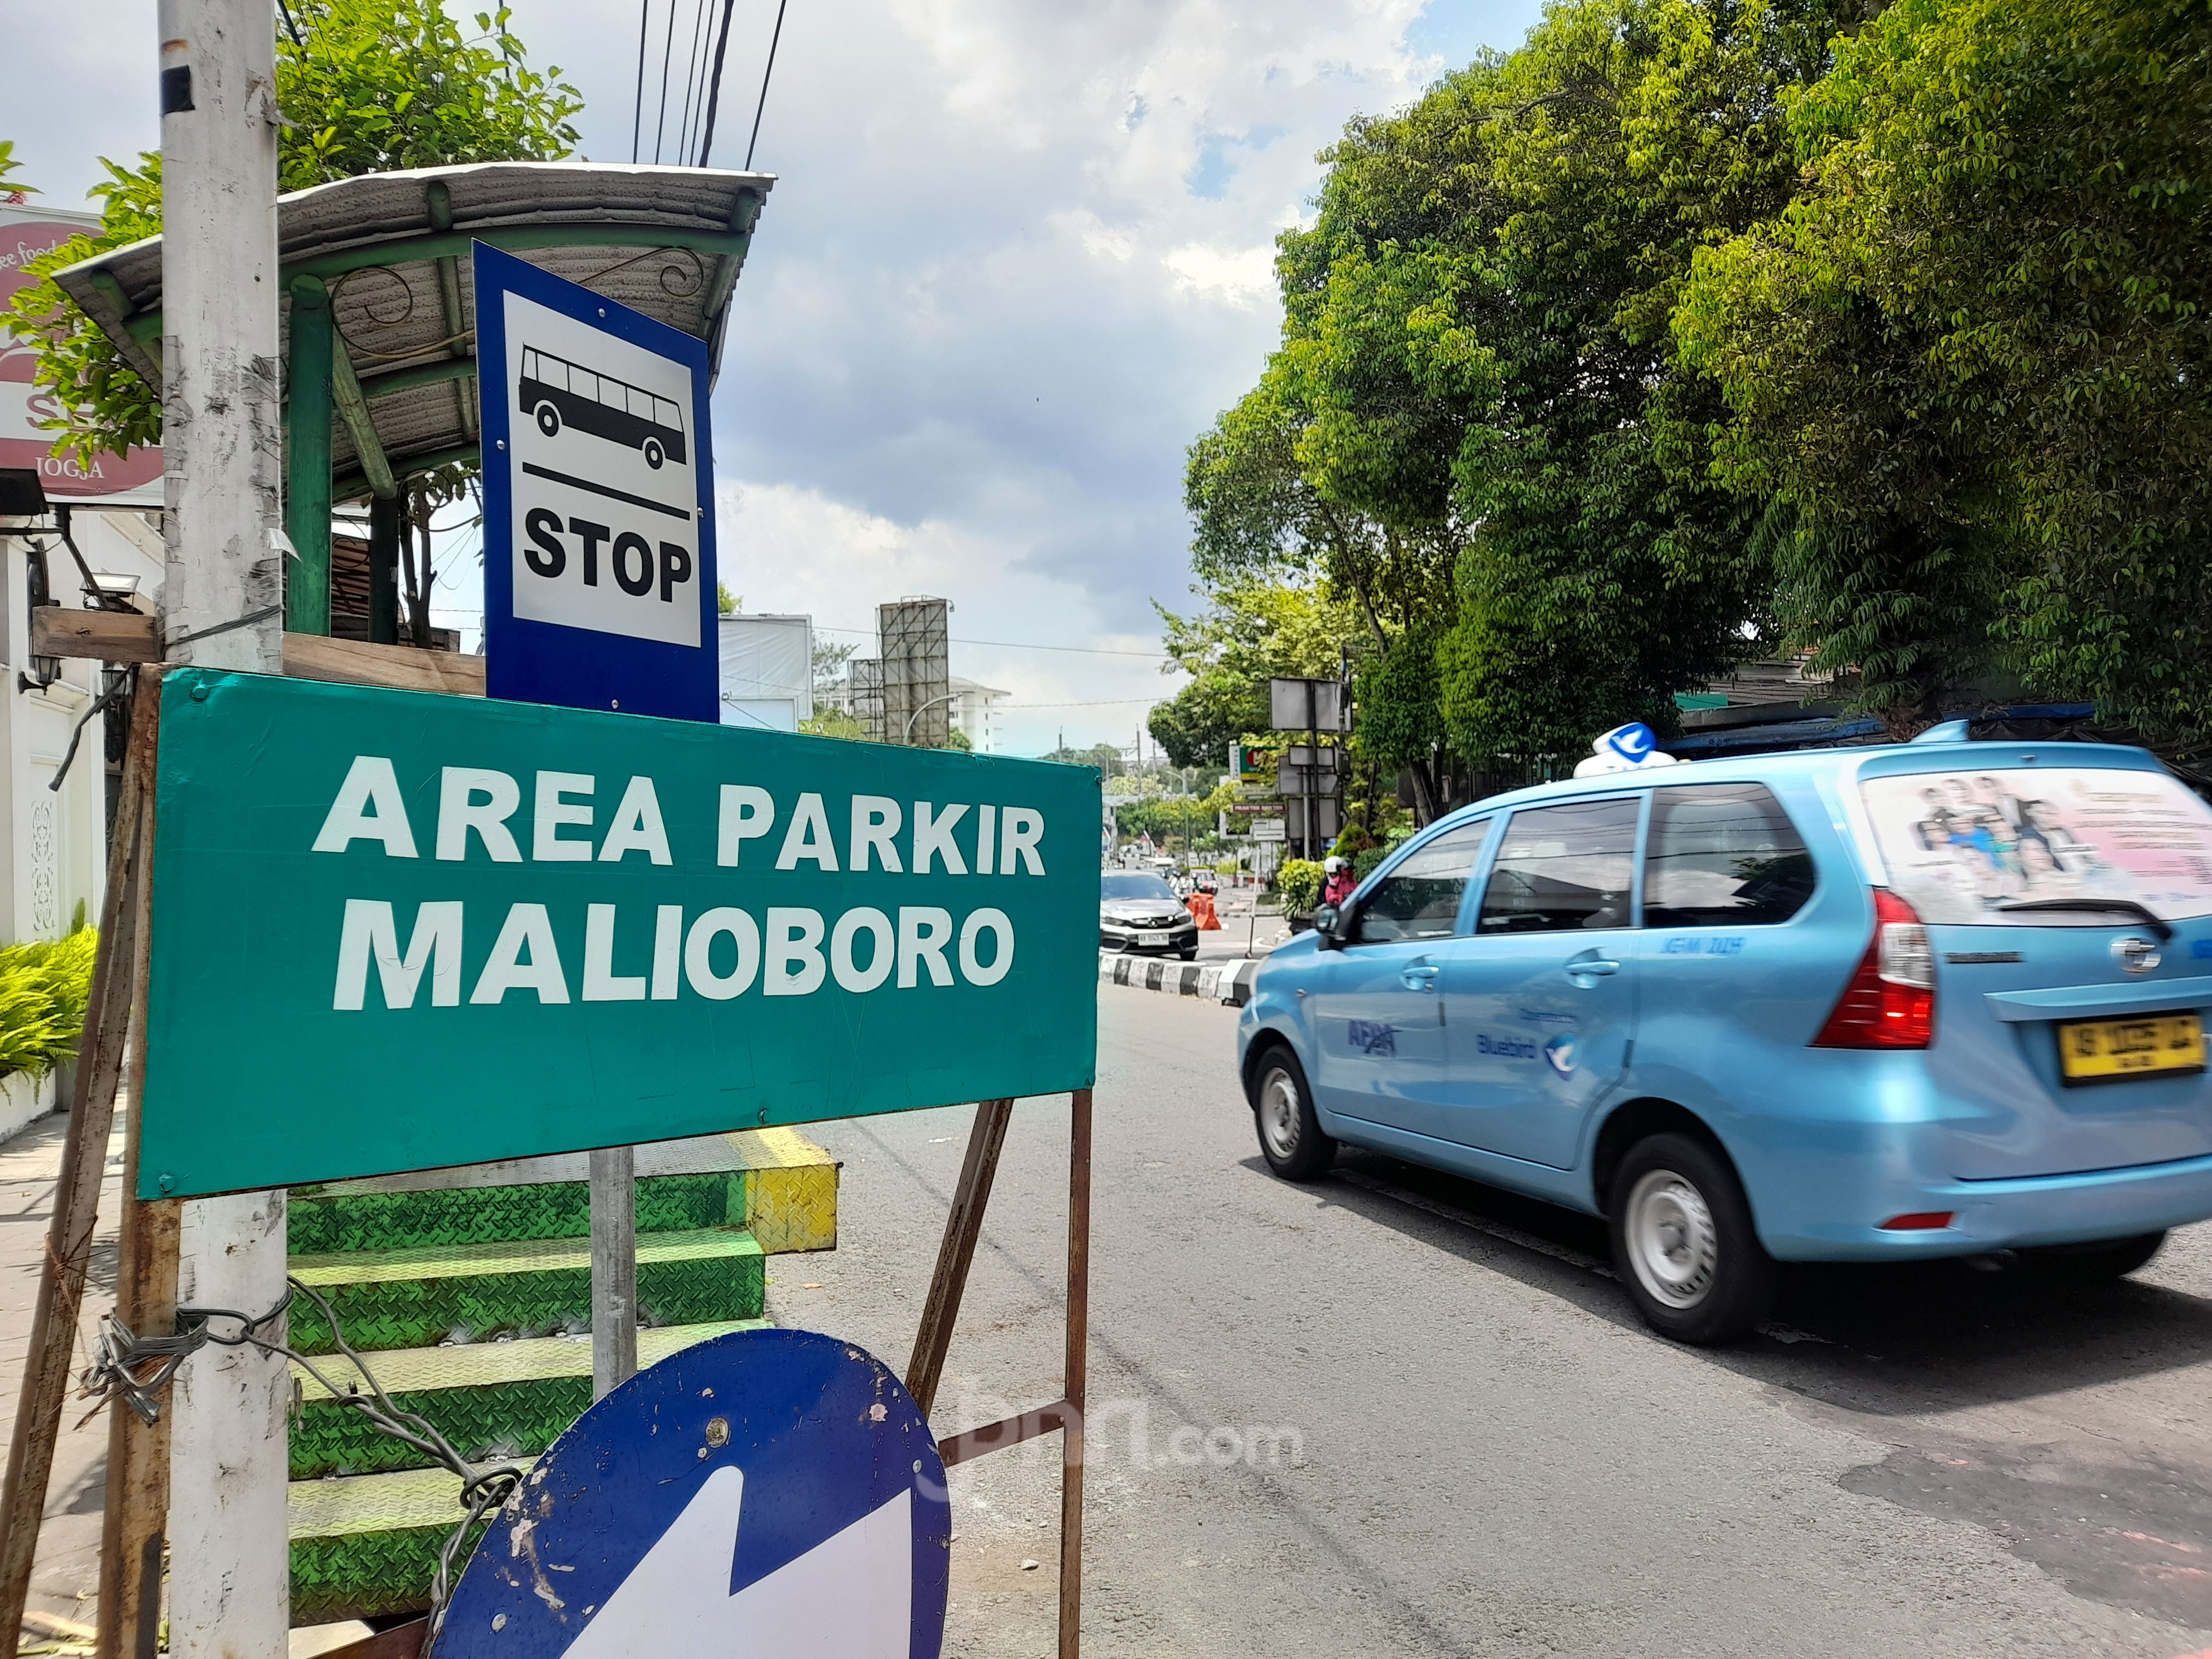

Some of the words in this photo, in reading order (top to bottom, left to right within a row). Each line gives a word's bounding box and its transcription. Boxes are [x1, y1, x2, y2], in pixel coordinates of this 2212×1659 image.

[524, 508, 692, 603] STOP
[312, 756, 673, 866] AREA
[717, 784, 1045, 876] PARKIR
[334, 899, 1014, 1010] MALIOBORO
